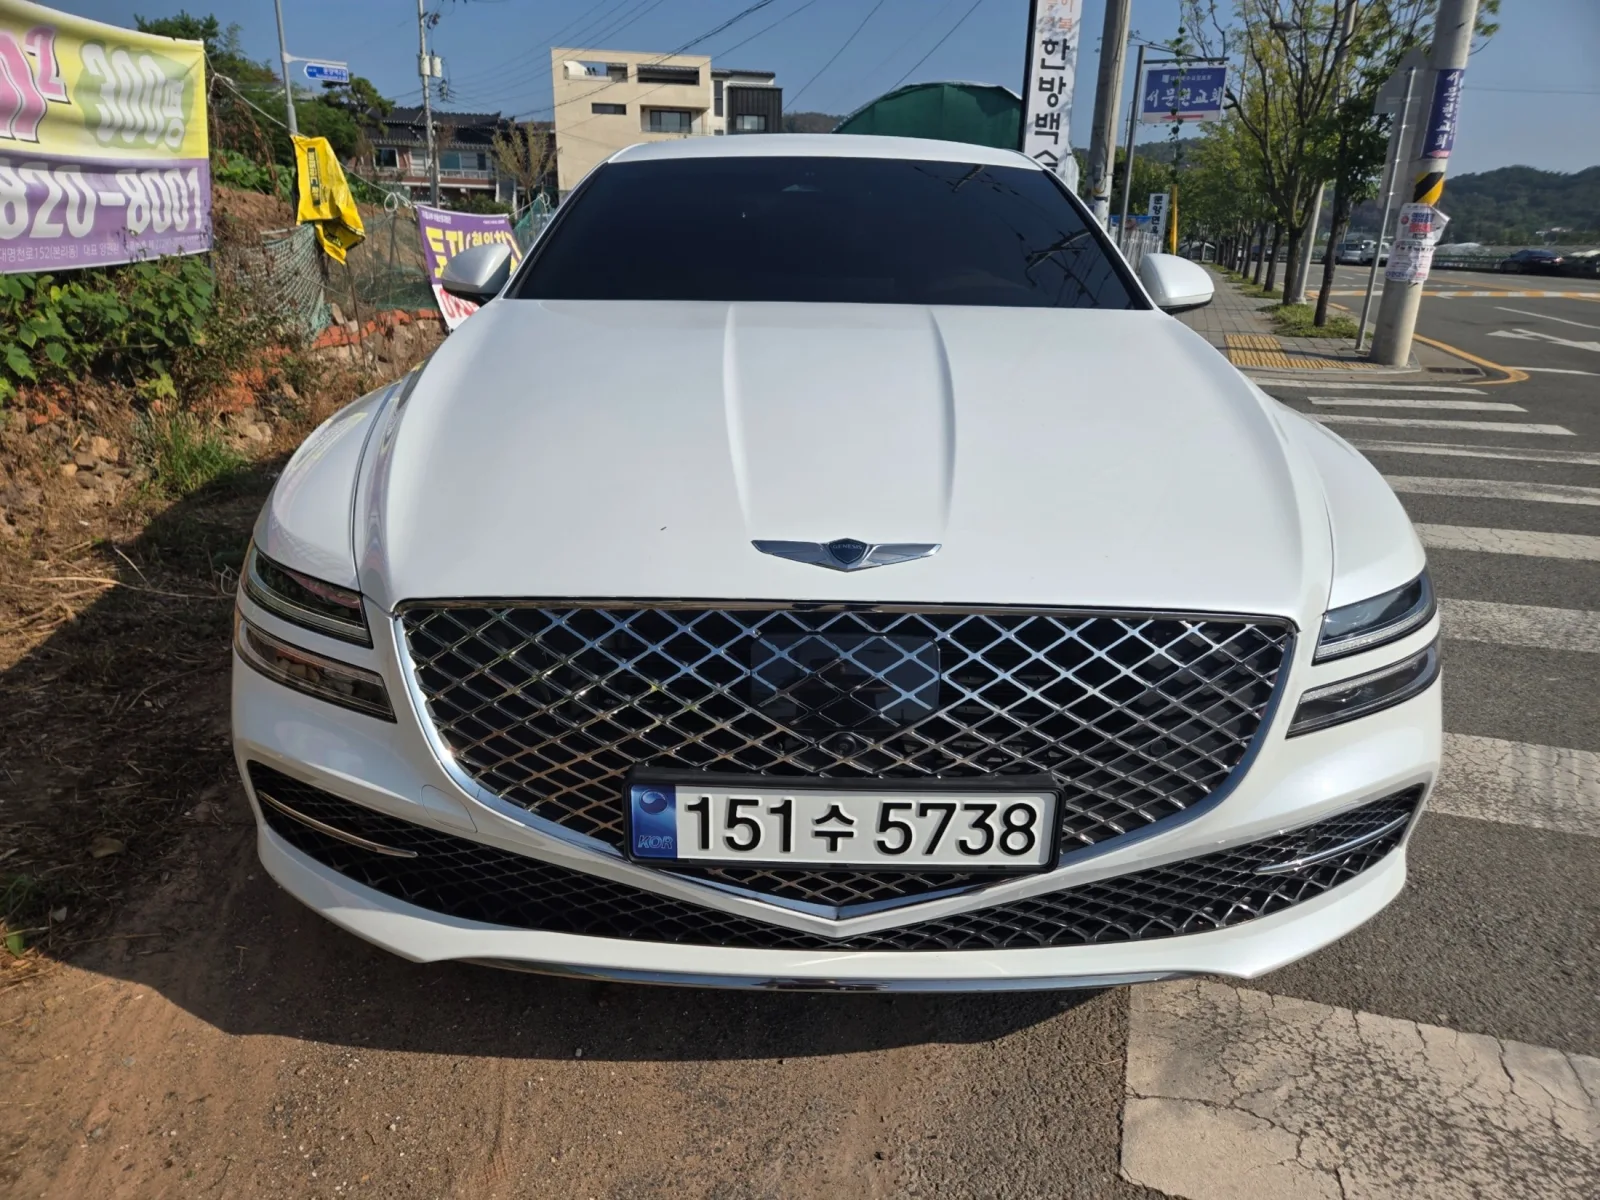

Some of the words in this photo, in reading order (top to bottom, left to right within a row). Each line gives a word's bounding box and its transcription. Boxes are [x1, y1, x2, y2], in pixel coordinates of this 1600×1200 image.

[80, 42, 186, 149] 300평
[832, 543, 864, 551] GENESIS
[637, 834, 674, 850] KOR
